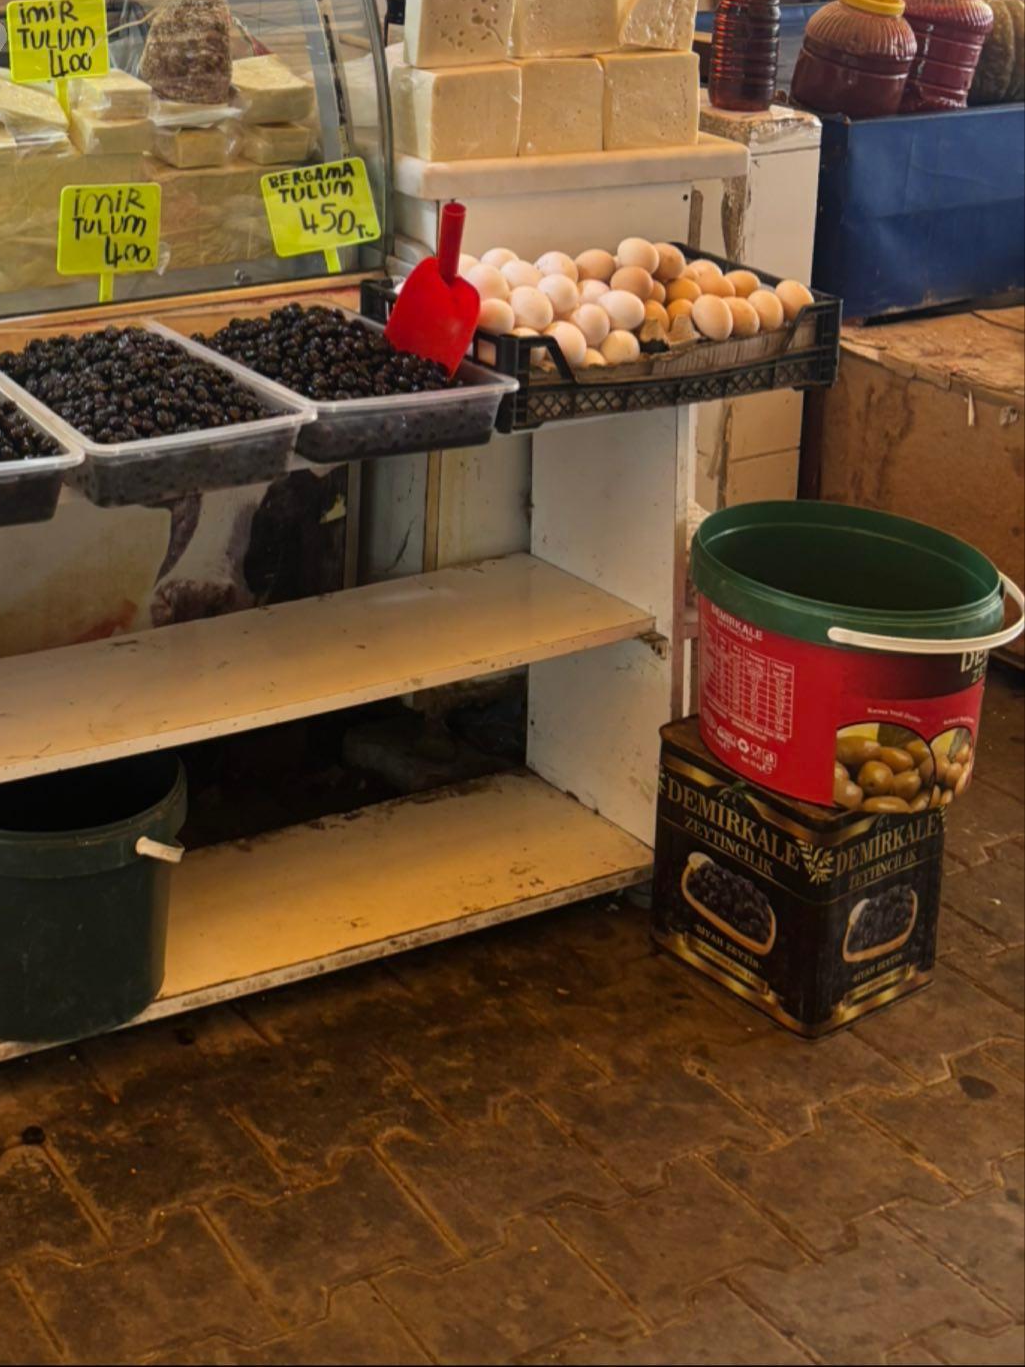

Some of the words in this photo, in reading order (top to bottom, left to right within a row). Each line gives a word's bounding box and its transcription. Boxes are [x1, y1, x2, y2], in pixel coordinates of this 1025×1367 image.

[49, 49, 92, 78] 400
[268, 162, 354, 188] BERGAMA
[278, 180, 353, 203] TULUM
[104, 234, 151, 269] 400
[666, 777, 801, 872] DEMİRKALE
